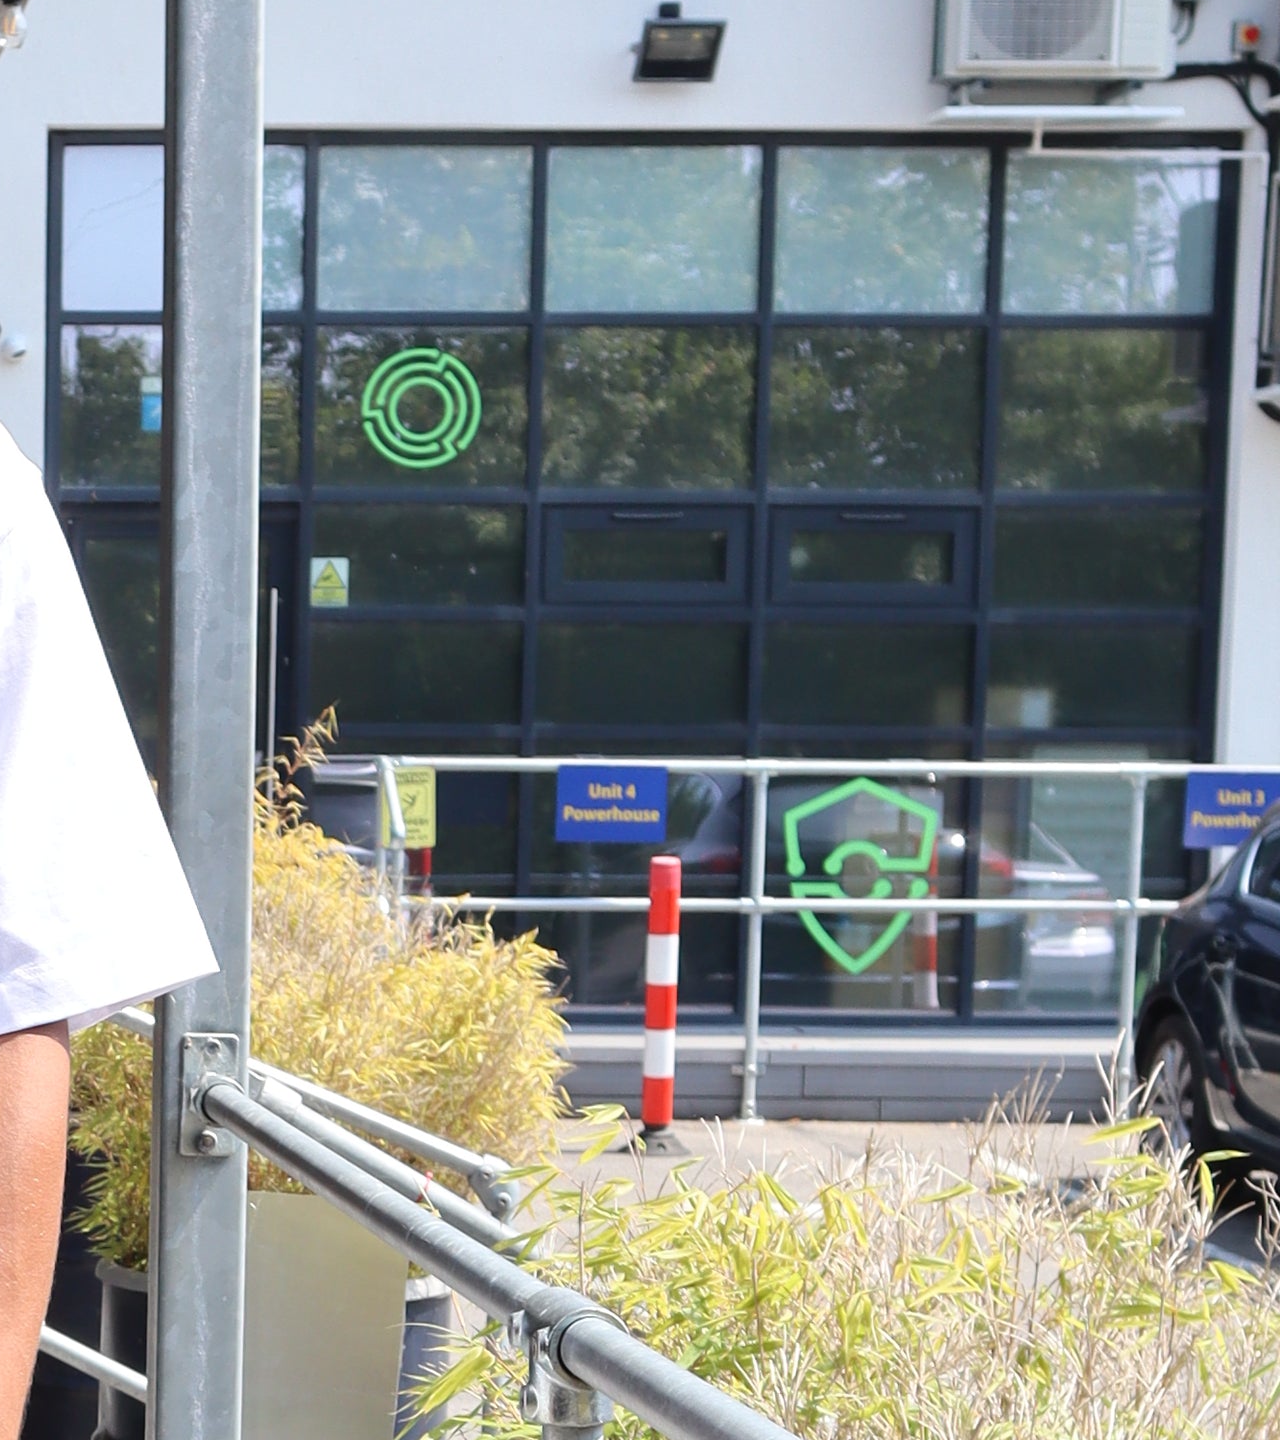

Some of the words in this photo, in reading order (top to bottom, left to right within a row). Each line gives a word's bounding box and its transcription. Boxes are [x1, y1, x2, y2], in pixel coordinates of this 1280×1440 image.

[588, 782, 623, 799] Unit
[625, 783, 636, 799] 4
[1217, 788, 1252, 806] Unit
[563, 804, 660, 822] Powerhouse
[1192, 809, 1260, 828] Powerho
